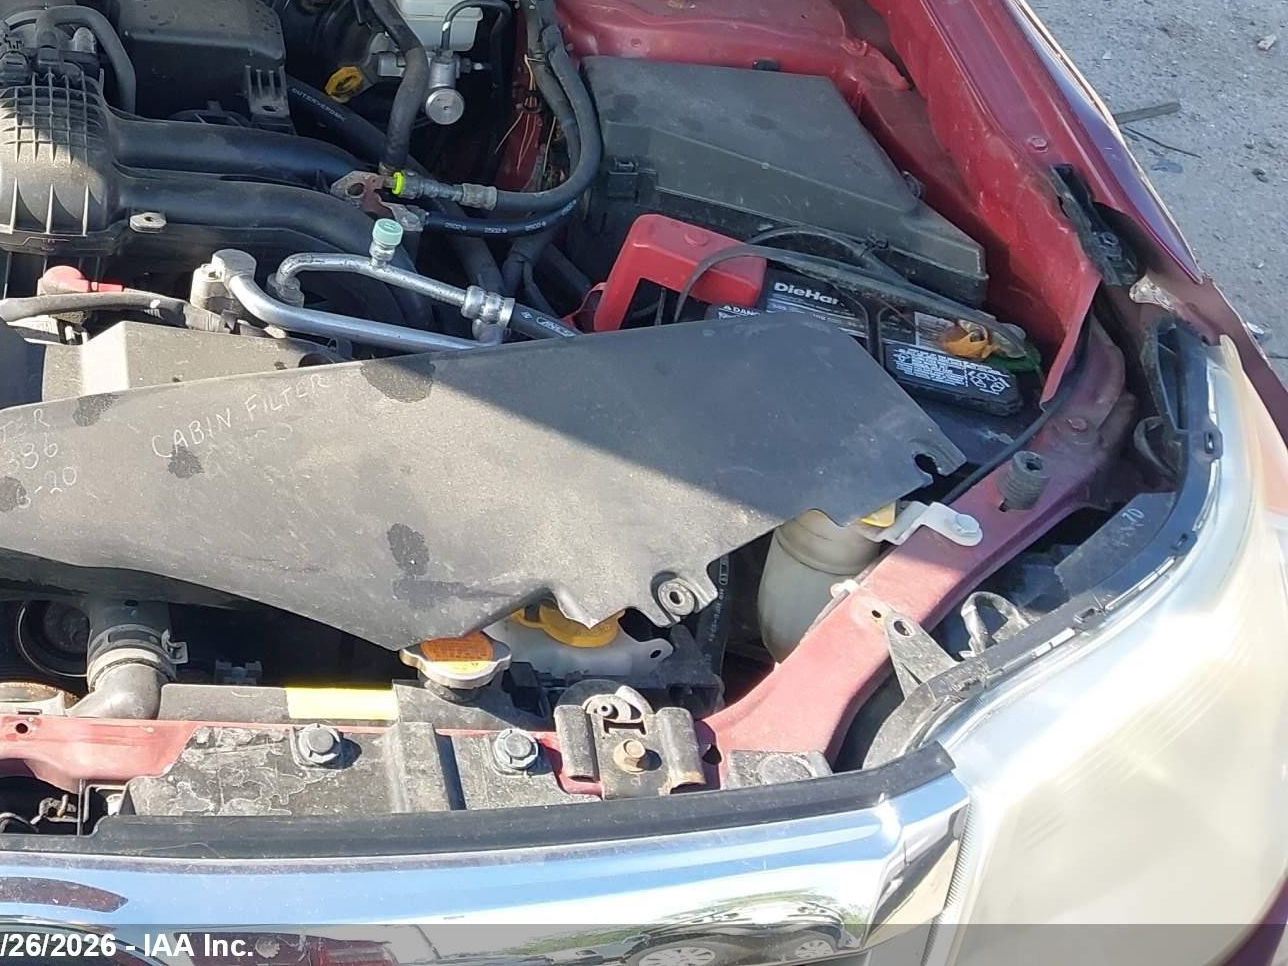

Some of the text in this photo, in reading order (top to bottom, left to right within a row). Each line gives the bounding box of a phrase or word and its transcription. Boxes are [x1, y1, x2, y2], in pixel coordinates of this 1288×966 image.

[774, 282, 845, 306] DieHar
[150, 407, 232, 458] CABIN
[243, 373, 330, 422] FILTER
